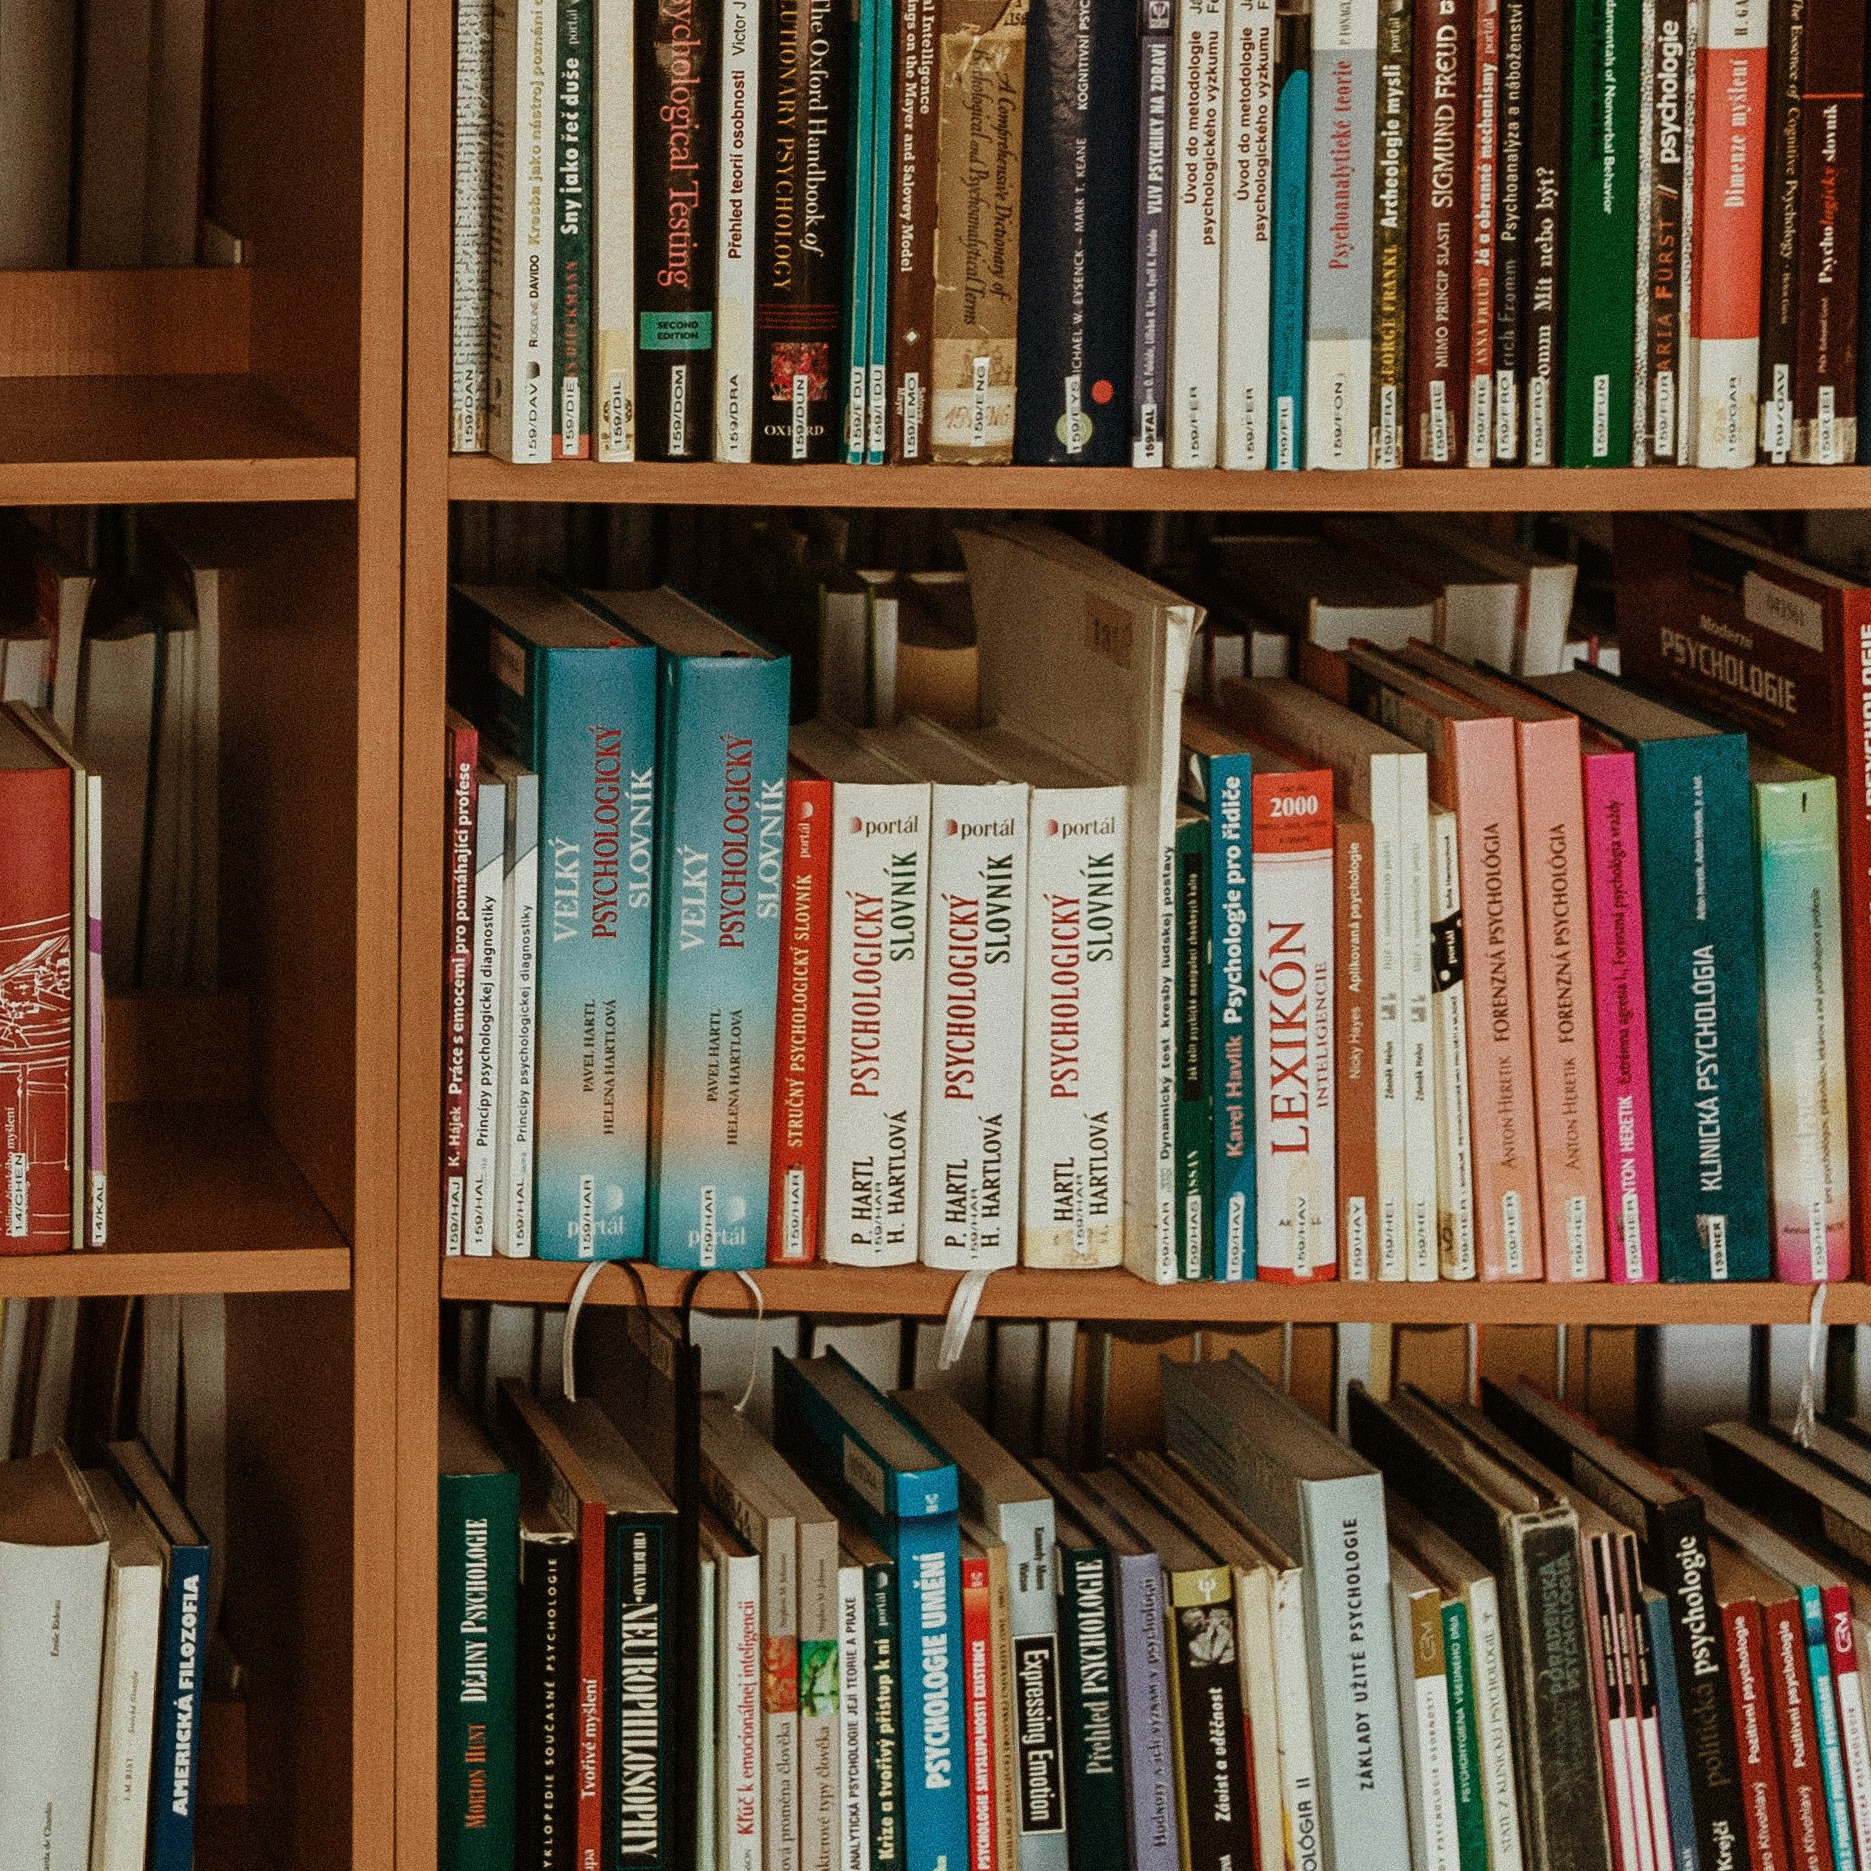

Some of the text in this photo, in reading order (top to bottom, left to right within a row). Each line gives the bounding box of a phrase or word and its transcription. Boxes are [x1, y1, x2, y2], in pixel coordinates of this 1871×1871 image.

[560, 58, 580, 233] Sny jako řeč duše
[731, 70, 744, 148] osobnosti
[1432, 26, 1458, 209] SIGMUND FREUD
[1659, 20, 1682, 163] psychologie
[658, 183, 698, 288] Testing
[728, 199, 742, 258] Přehled
[673, 369, 684, 450] 159/DOM
[865, 816, 918, 837] portál
[1270, 796, 1317, 816] 2000
[481, 895, 495, 977] diagnostiky
[885, 852, 915, 960] SLOVNÍK
[479, 982, 494, 1085] psychologickej
[847, 892, 881, 1095] PSYCHOLOGICKÝ
[1260, 922, 1308, 1153] LEXIKÓN
[1691, 944, 1722, 1191] KLINICKÁ PSYCHOLÓGIA
[458, 1519, 491, 1701] DĚJINY PSYCHOLOGIE
[1343, 1518, 1374, 1791] ZÁKLADY UŽITÉ PSYCHOLOGIE
[1678, 1535, 1719, 1676] psychologie
[170, 1575, 197, 1815] AMERICKÁ FILOZOFIA
